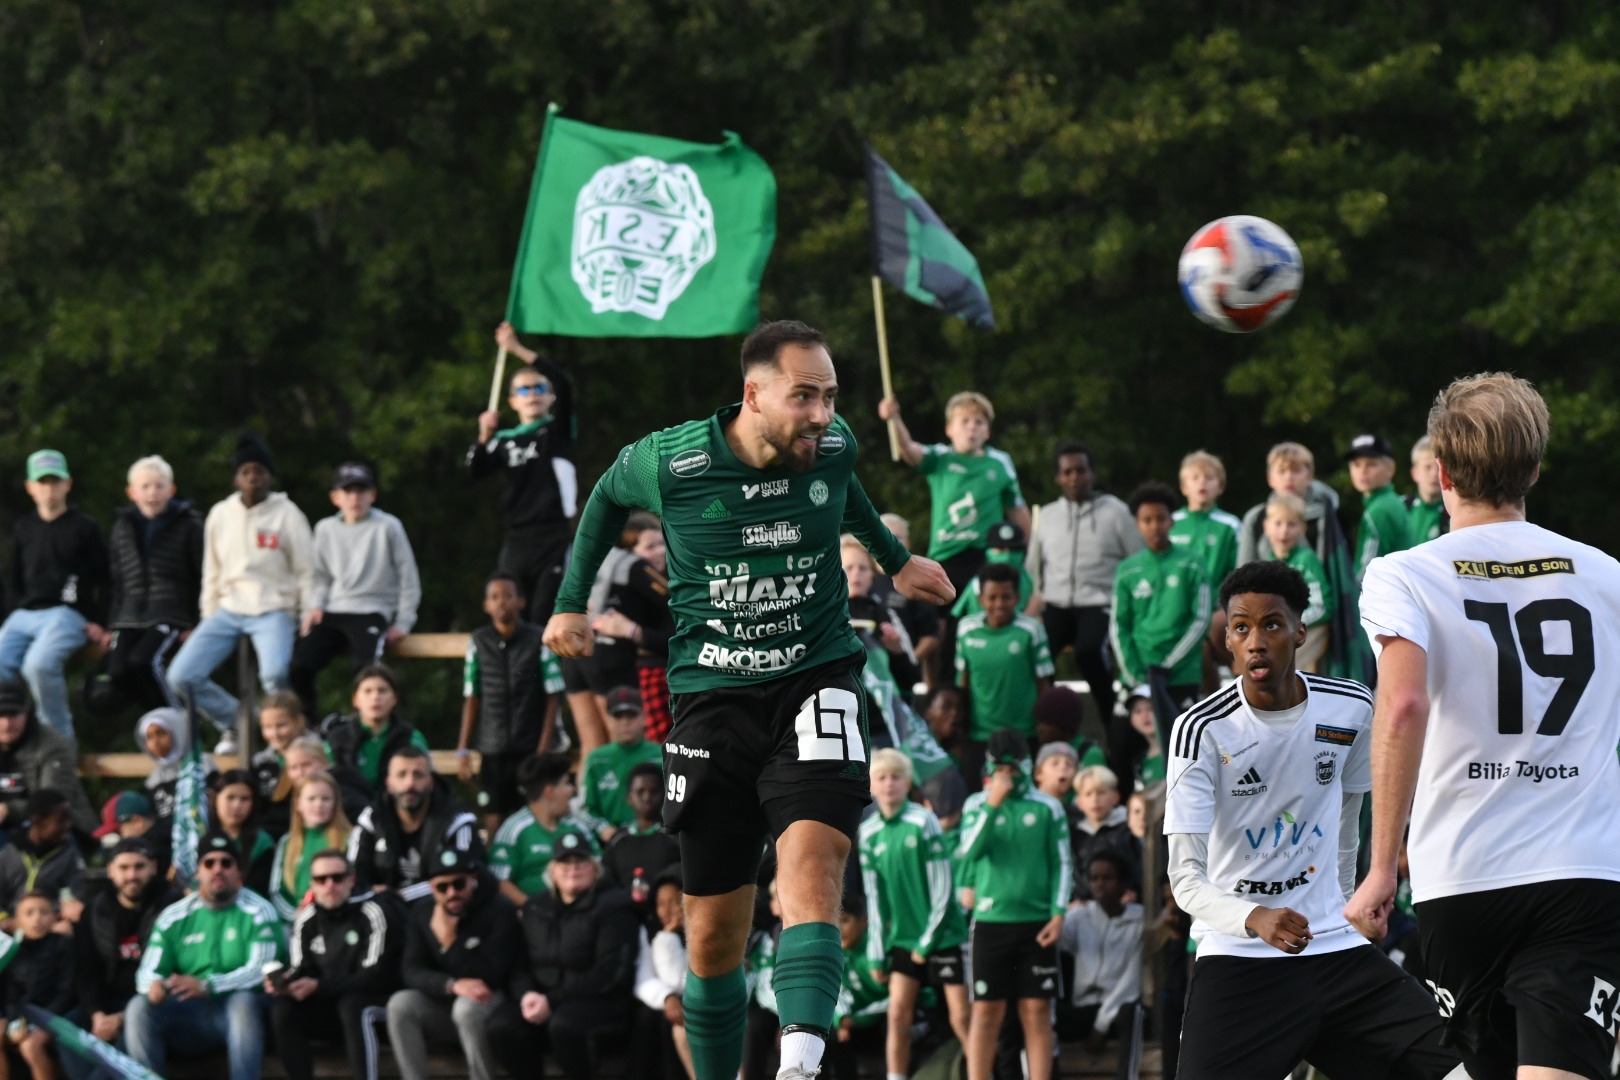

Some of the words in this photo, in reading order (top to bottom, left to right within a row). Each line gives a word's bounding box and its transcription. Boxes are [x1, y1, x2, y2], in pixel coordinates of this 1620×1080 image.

[760, 479, 789, 490] INTER
[761, 487, 789, 497] SPORT
[701, 507, 731, 519] adidas
[744, 525, 799, 547] Sibylla
[1455, 561, 1485, 576] XL
[1491, 564, 1524, 575] STEN
[1528, 563, 1538, 573] &
[1541, 560, 1569, 572] SON
[734, 613, 802, 641] Accesit
[698, 642, 807, 670] ENKÖPING
[1463, 598, 1596, 736] 19
[679, 744, 710, 759] Toyota
[1468, 762, 1510, 780] Bilia
[1515, 760, 1580, 783] Toyota
[667, 773, 687, 803] 99
[1231, 785, 1268, 797] stadium
[1234, 870, 1309, 896] FRANK
